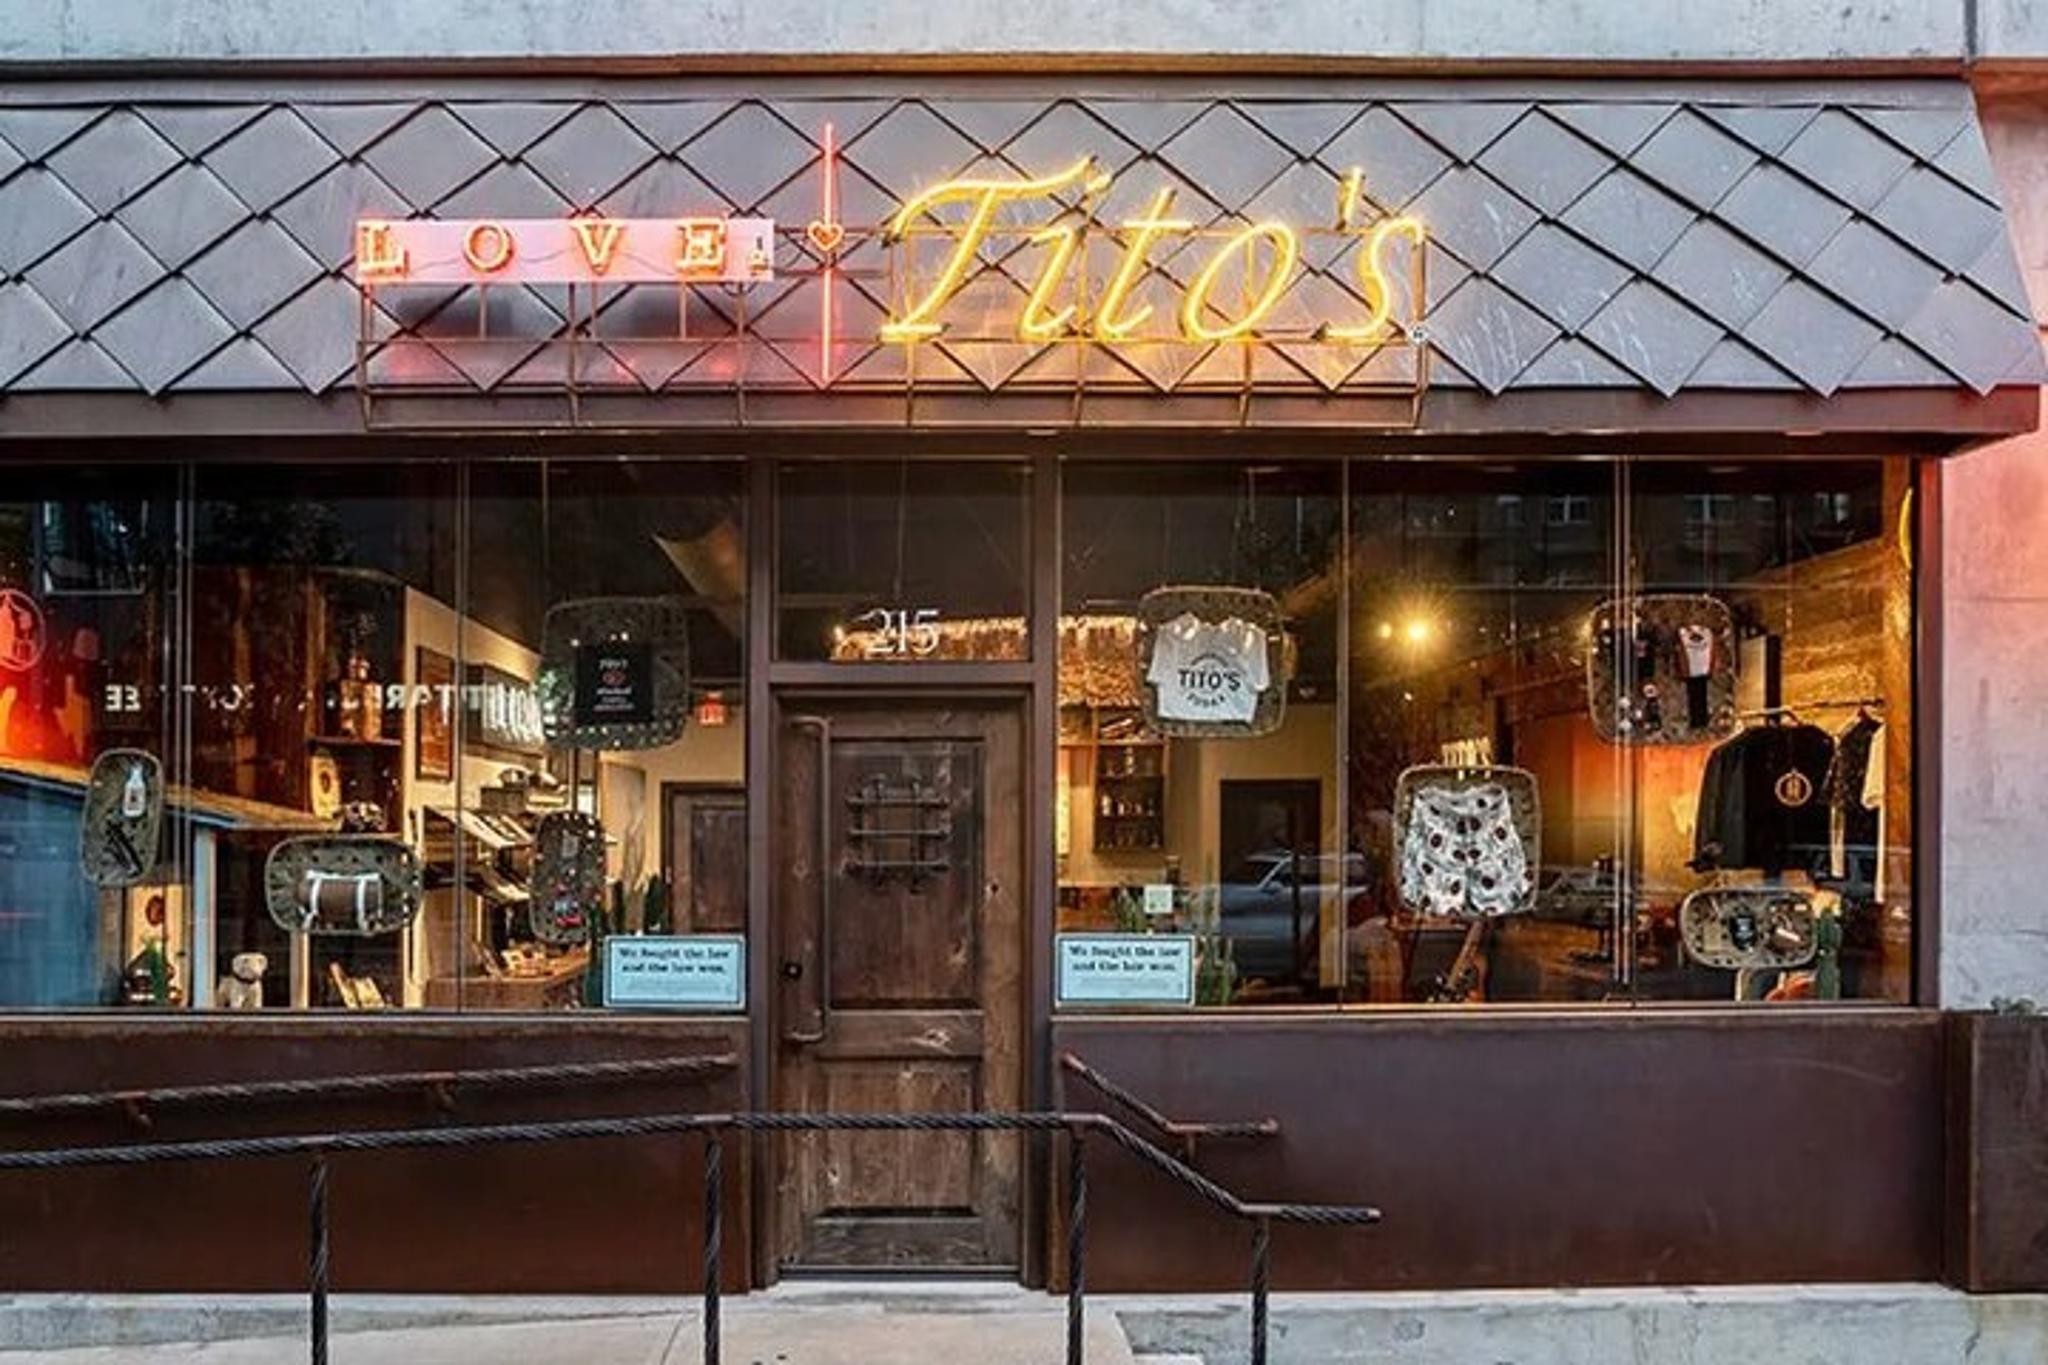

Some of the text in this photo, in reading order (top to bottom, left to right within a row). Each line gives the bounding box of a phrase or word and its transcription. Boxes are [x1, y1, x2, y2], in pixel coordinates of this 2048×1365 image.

[358, 216, 728, 276] LOVE
[880, 154, 1426, 343] Tito's
[857, 608, 940, 655] 215
[1177, 668, 1241, 692] TITO'S
